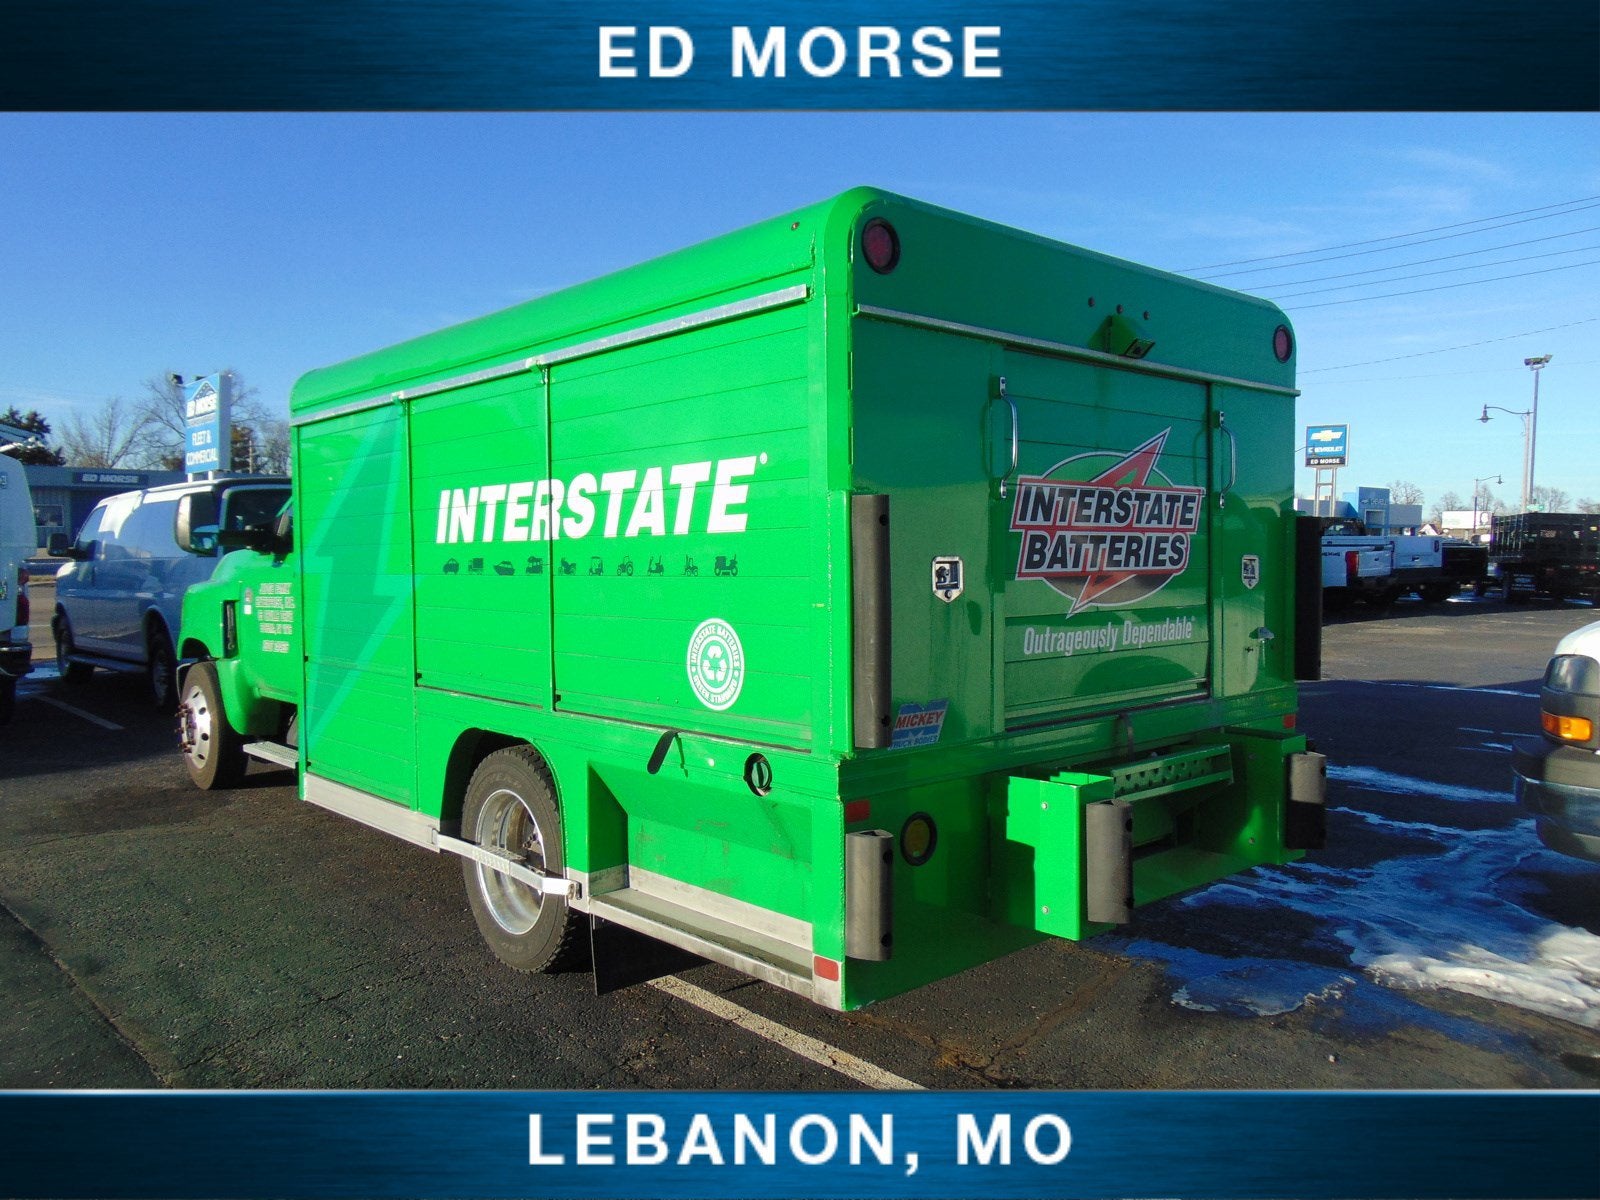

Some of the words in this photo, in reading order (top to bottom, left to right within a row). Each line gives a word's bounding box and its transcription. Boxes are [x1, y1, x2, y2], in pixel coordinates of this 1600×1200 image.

[82, 473, 98, 482] ED
[99, 474, 139, 483] MORSE
[436, 455, 757, 544] INTERSTATE
[1017, 484, 1200, 528] INTERSTATE
[1024, 531, 1187, 571] BATTERIES
[1023, 622, 1119, 657] Outrageously
[1122, 616, 1193, 648] Dependable
[896, 711, 944, 729] MICKEY
